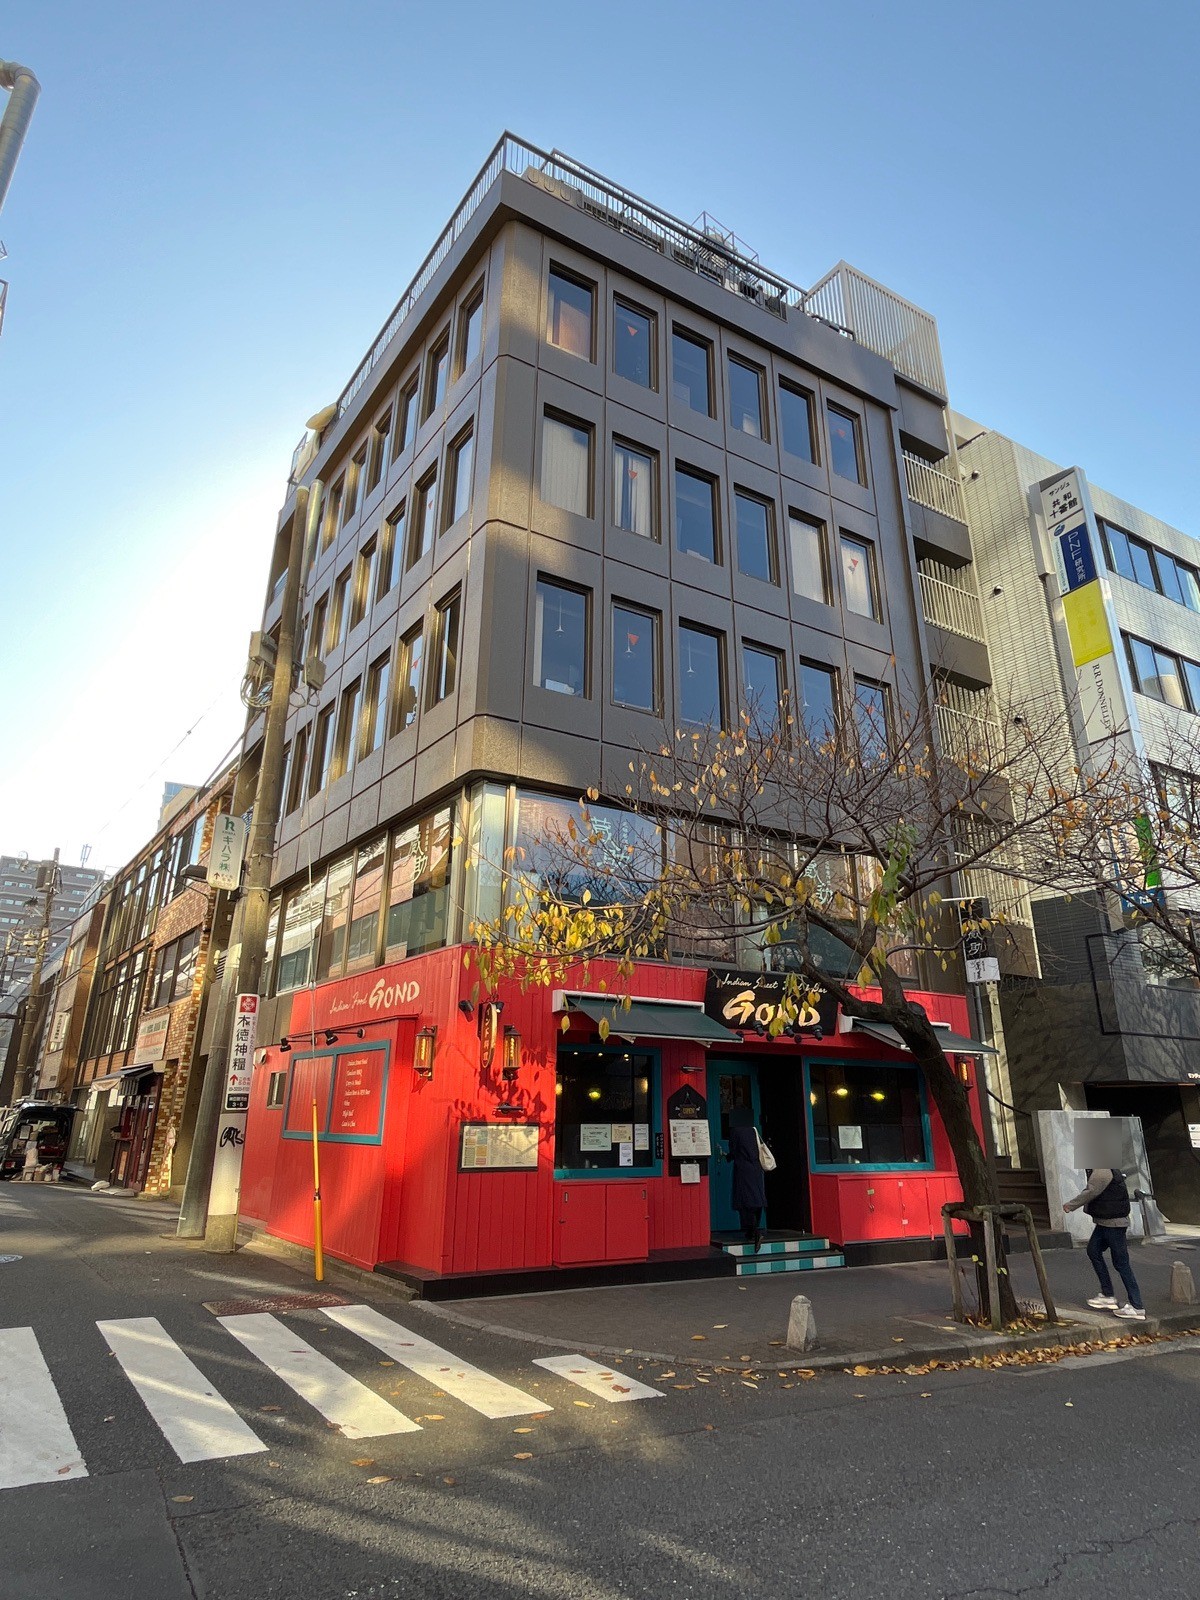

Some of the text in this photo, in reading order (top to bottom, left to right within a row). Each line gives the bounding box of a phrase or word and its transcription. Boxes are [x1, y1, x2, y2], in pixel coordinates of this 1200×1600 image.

[368, 978, 420, 1011] GOND
[722, 973, 752, 987] Indian
[231, 1014, 251, 1071] 木徳神糧
